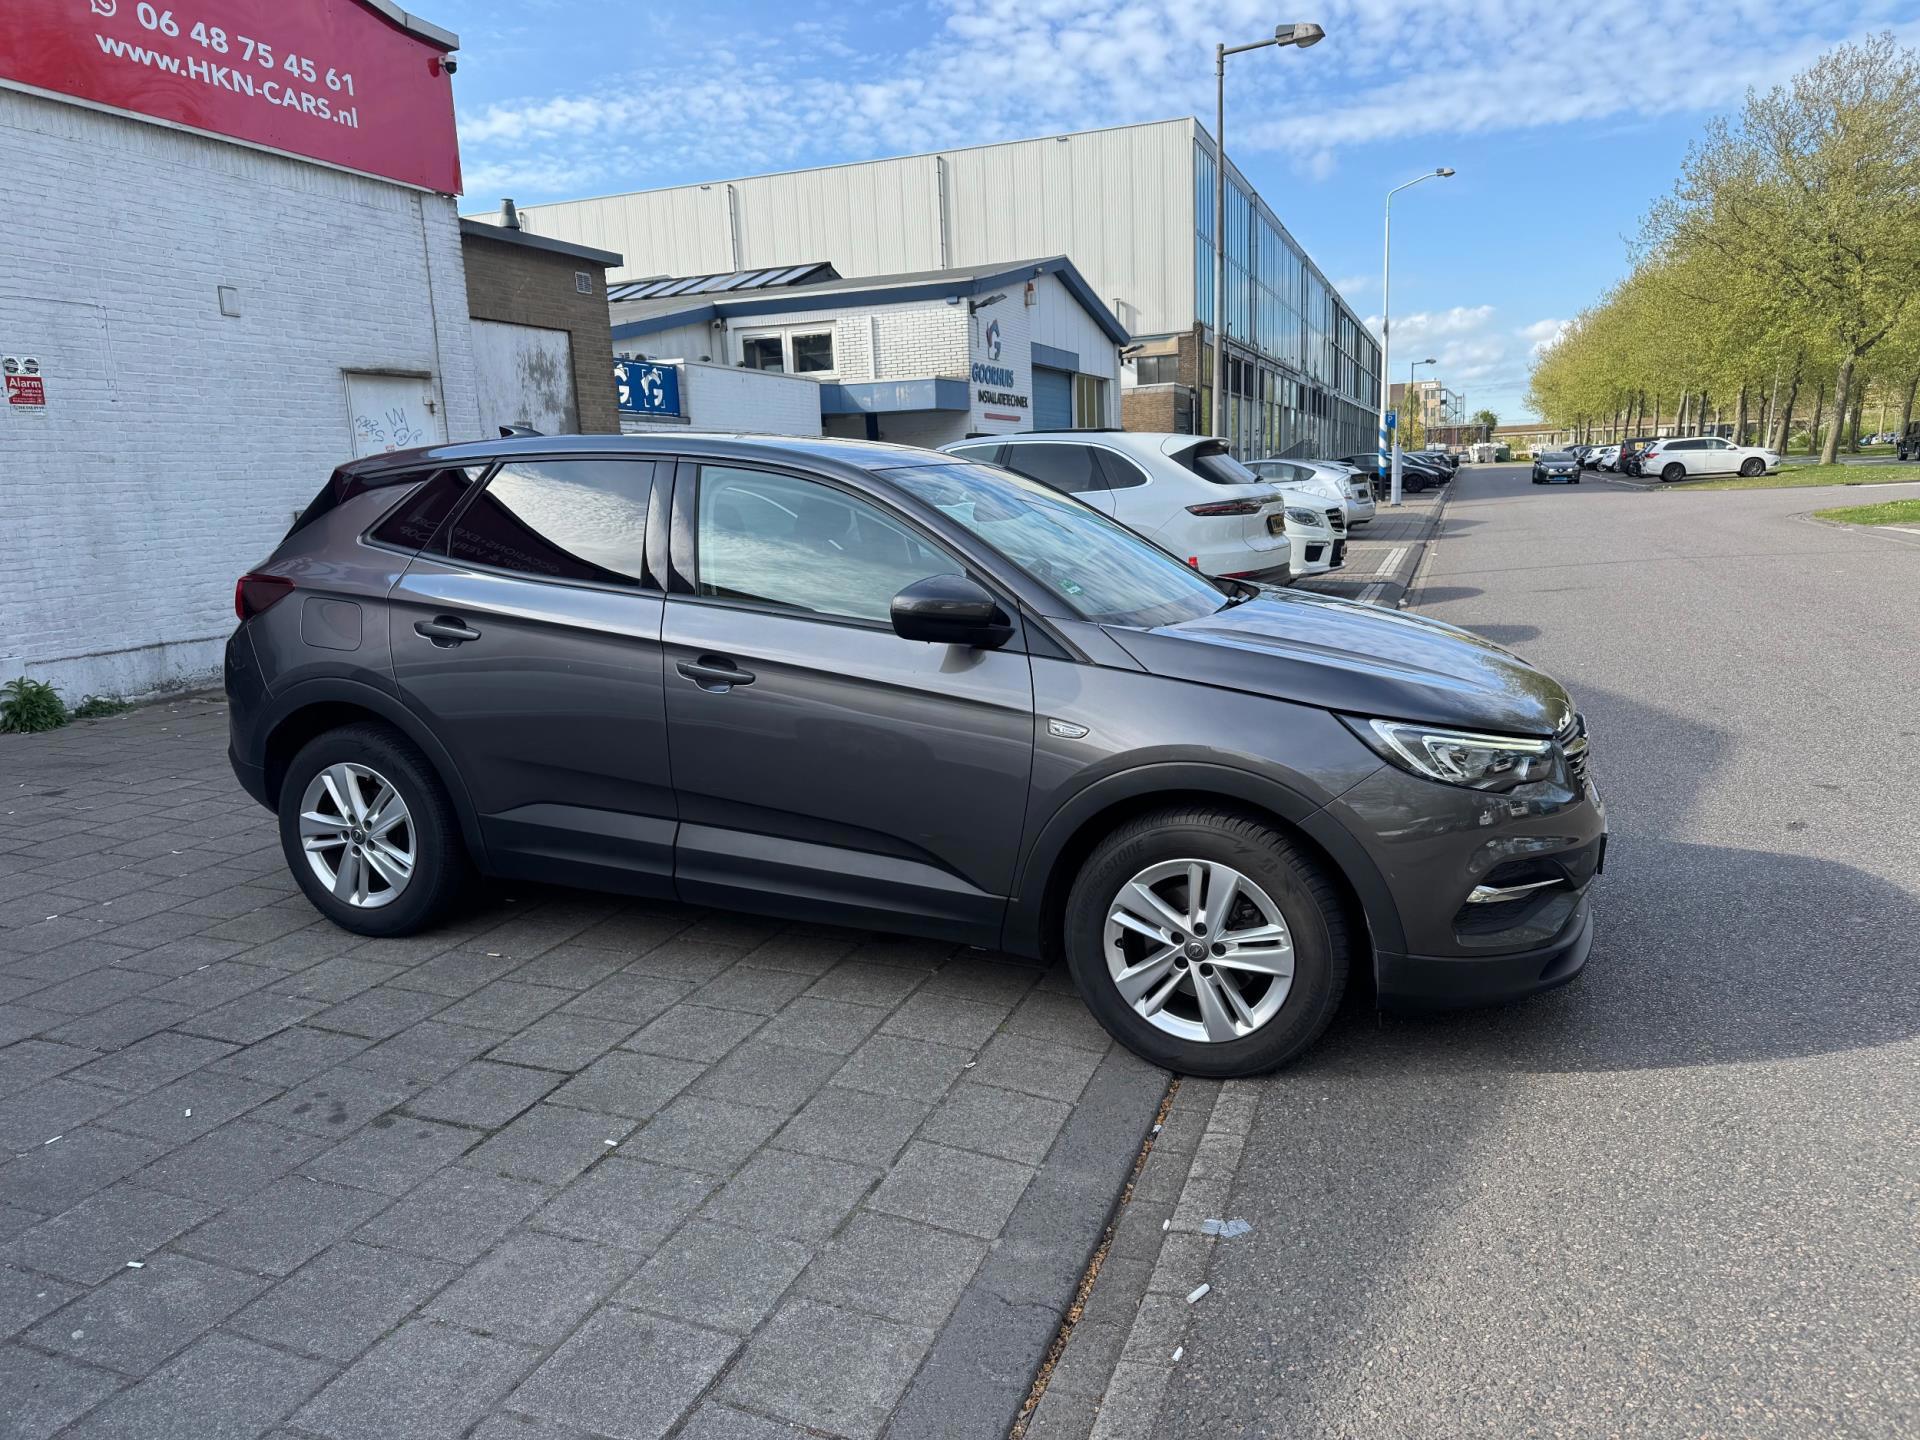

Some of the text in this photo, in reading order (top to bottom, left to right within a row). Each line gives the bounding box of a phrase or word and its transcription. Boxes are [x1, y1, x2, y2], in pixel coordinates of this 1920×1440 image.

[137, 2, 354, 96] 06 48 75 45 61
[95, 33, 359, 128] www.HKN-CARS.nl
[9, 377, 41, 388] Alarm
[971, 362, 1014, 388] GOORHUIS
